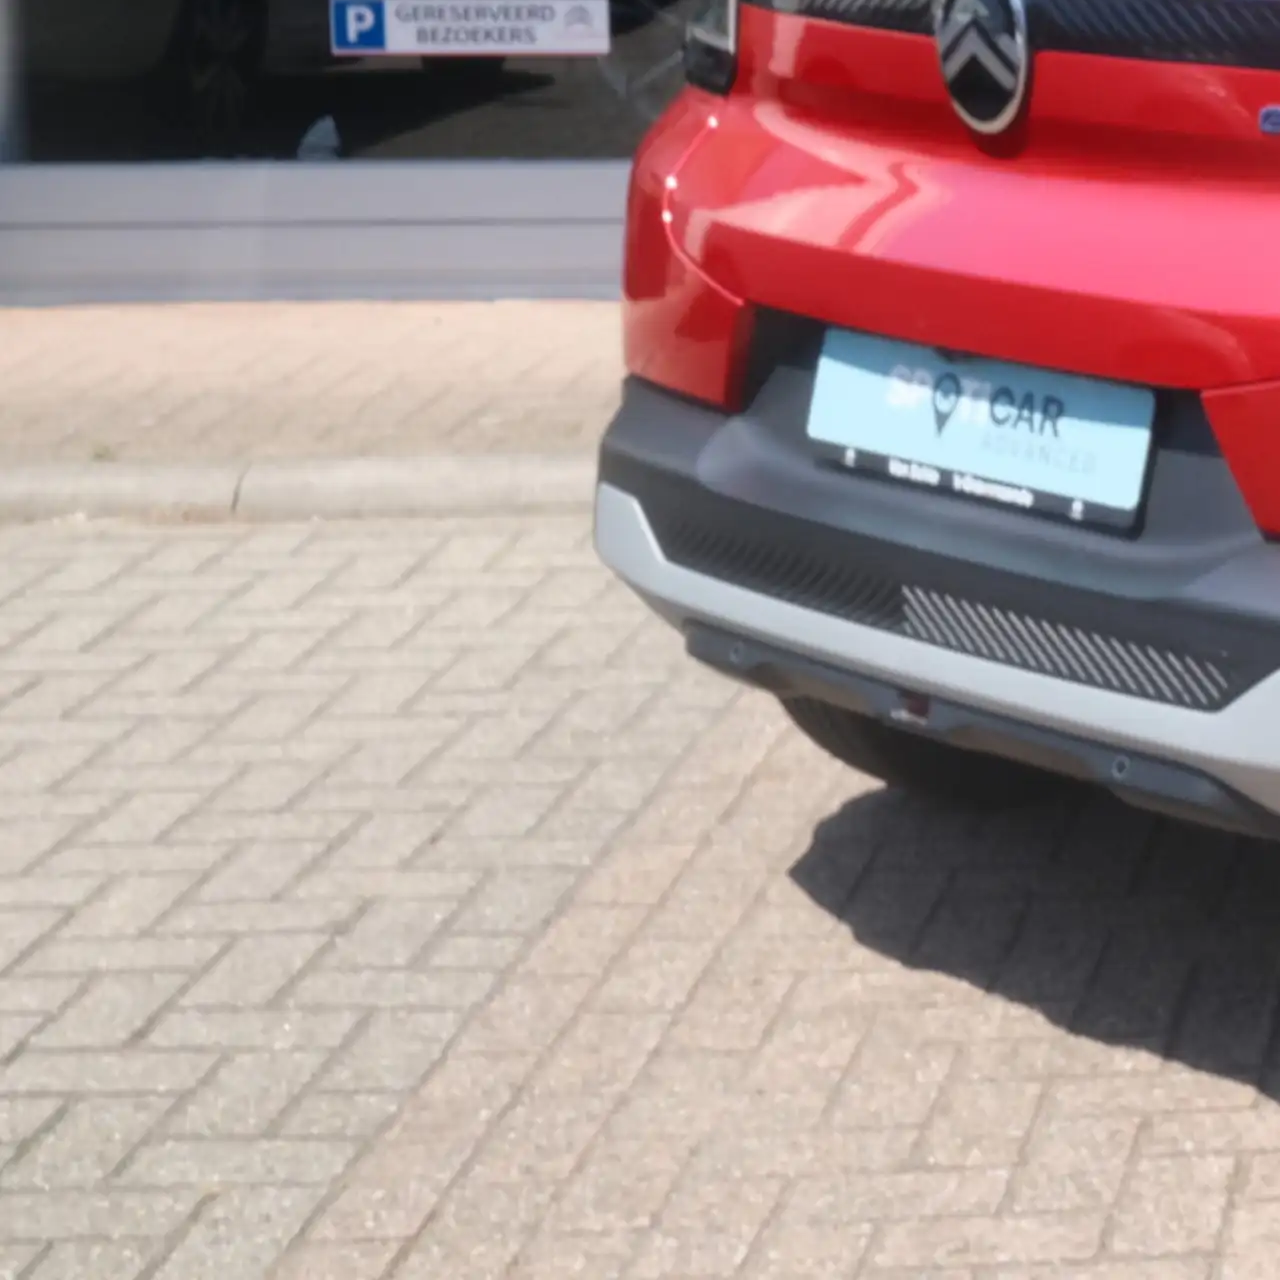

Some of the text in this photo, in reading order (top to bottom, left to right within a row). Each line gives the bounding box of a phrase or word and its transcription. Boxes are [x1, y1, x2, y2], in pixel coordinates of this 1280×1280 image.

[346, 4, 375, 44] P
[395, 4, 556, 24] GERESERVEERD
[416, 26, 537, 45] BEZOEKERS
